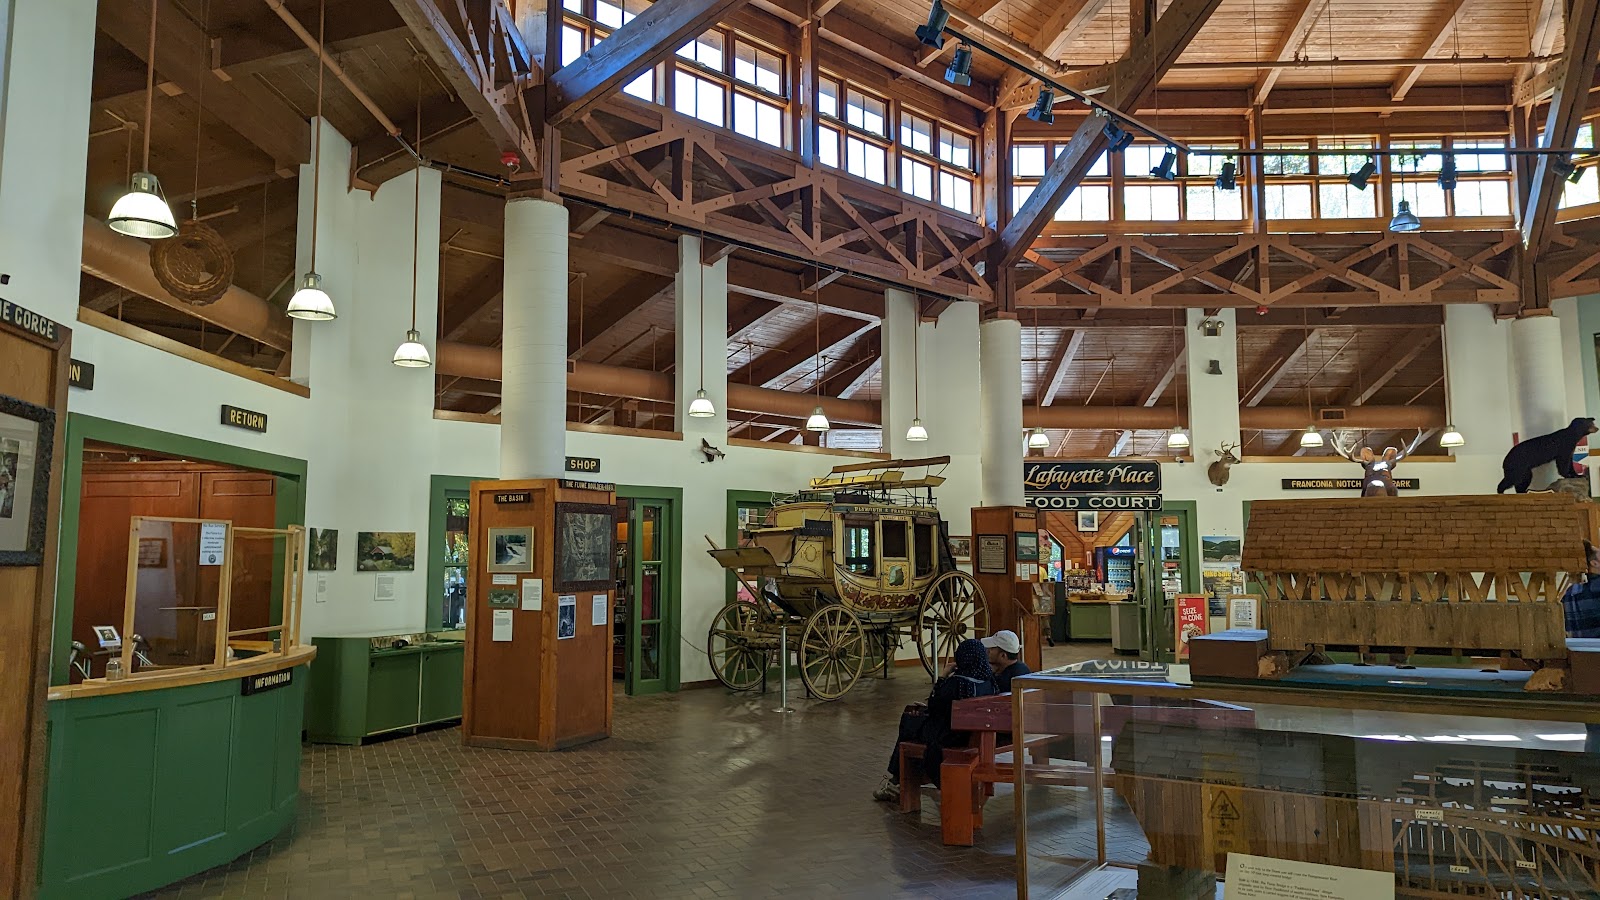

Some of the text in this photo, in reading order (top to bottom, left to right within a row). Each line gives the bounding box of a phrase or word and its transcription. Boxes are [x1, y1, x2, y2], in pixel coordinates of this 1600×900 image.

[230, 409, 264, 428] RETURN
[570, 460, 597, 470] SHOP
[1024, 464, 1156, 490] Lafayette Place
[1024, 497, 1157, 508] FOOD COURT
[1182, 607, 1197, 615] SEIZE
[1188, 613, 1203, 622] CONE
[255, 672, 290, 689] INFORMATION
